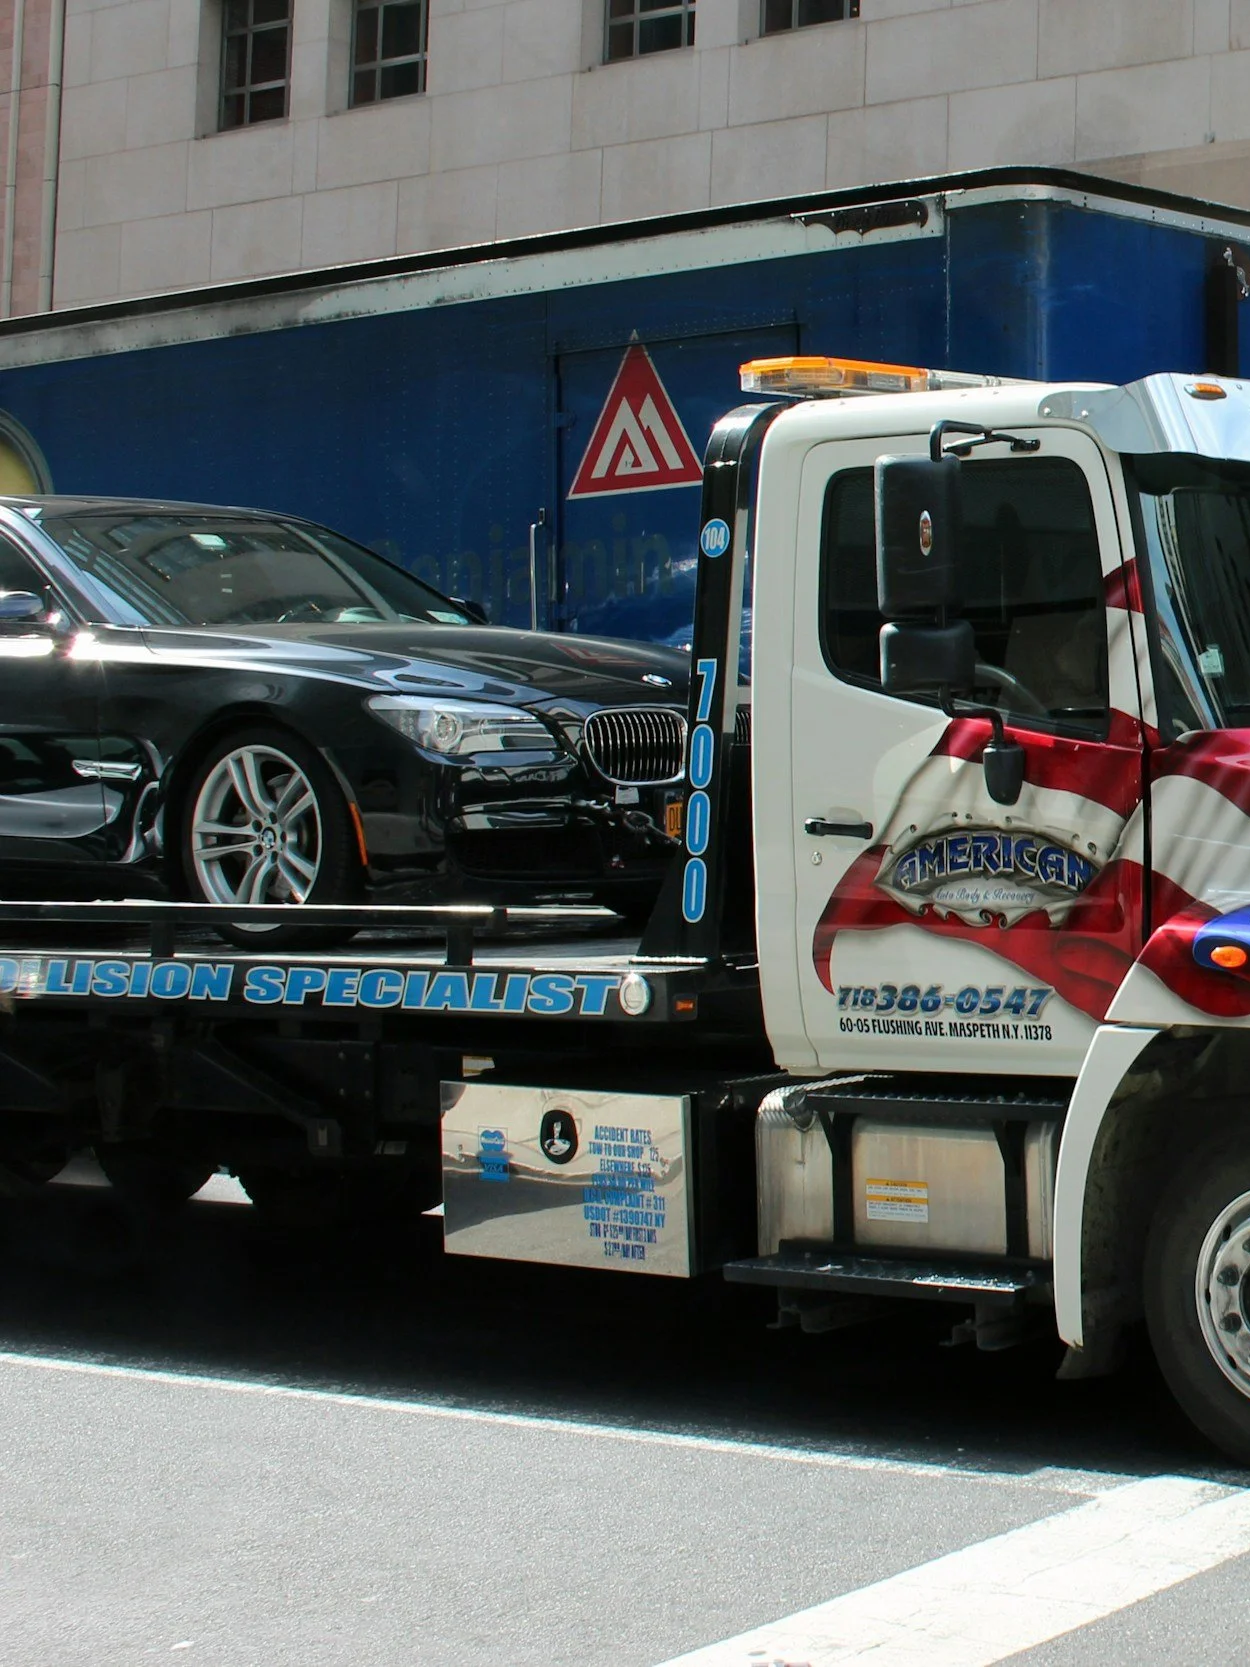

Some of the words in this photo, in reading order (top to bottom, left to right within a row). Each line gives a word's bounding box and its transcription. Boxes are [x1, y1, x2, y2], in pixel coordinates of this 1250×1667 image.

[704, 525, 725, 550] 104
[893, 831, 1096, 891] AMERICAN
[956, 887, 980, 904] Body
[992, 887, 1036, 905] Recovery
[243, 965, 621, 1016] SPECIALIST
[839, 1017, 870, 1033] 60-05
[872, 1020, 922, 1036] FLUSHING
[924, 1021, 948, 1037] AVE.
[949, 1022, 1000, 1039] MASPETH
[1024, 1024, 1052, 1041] 11378
[594, 1125, 628, 1143] ACCIDENT
[630, 1128, 652, 1146] RATES
[584, 1205, 610, 1222] USDOT
